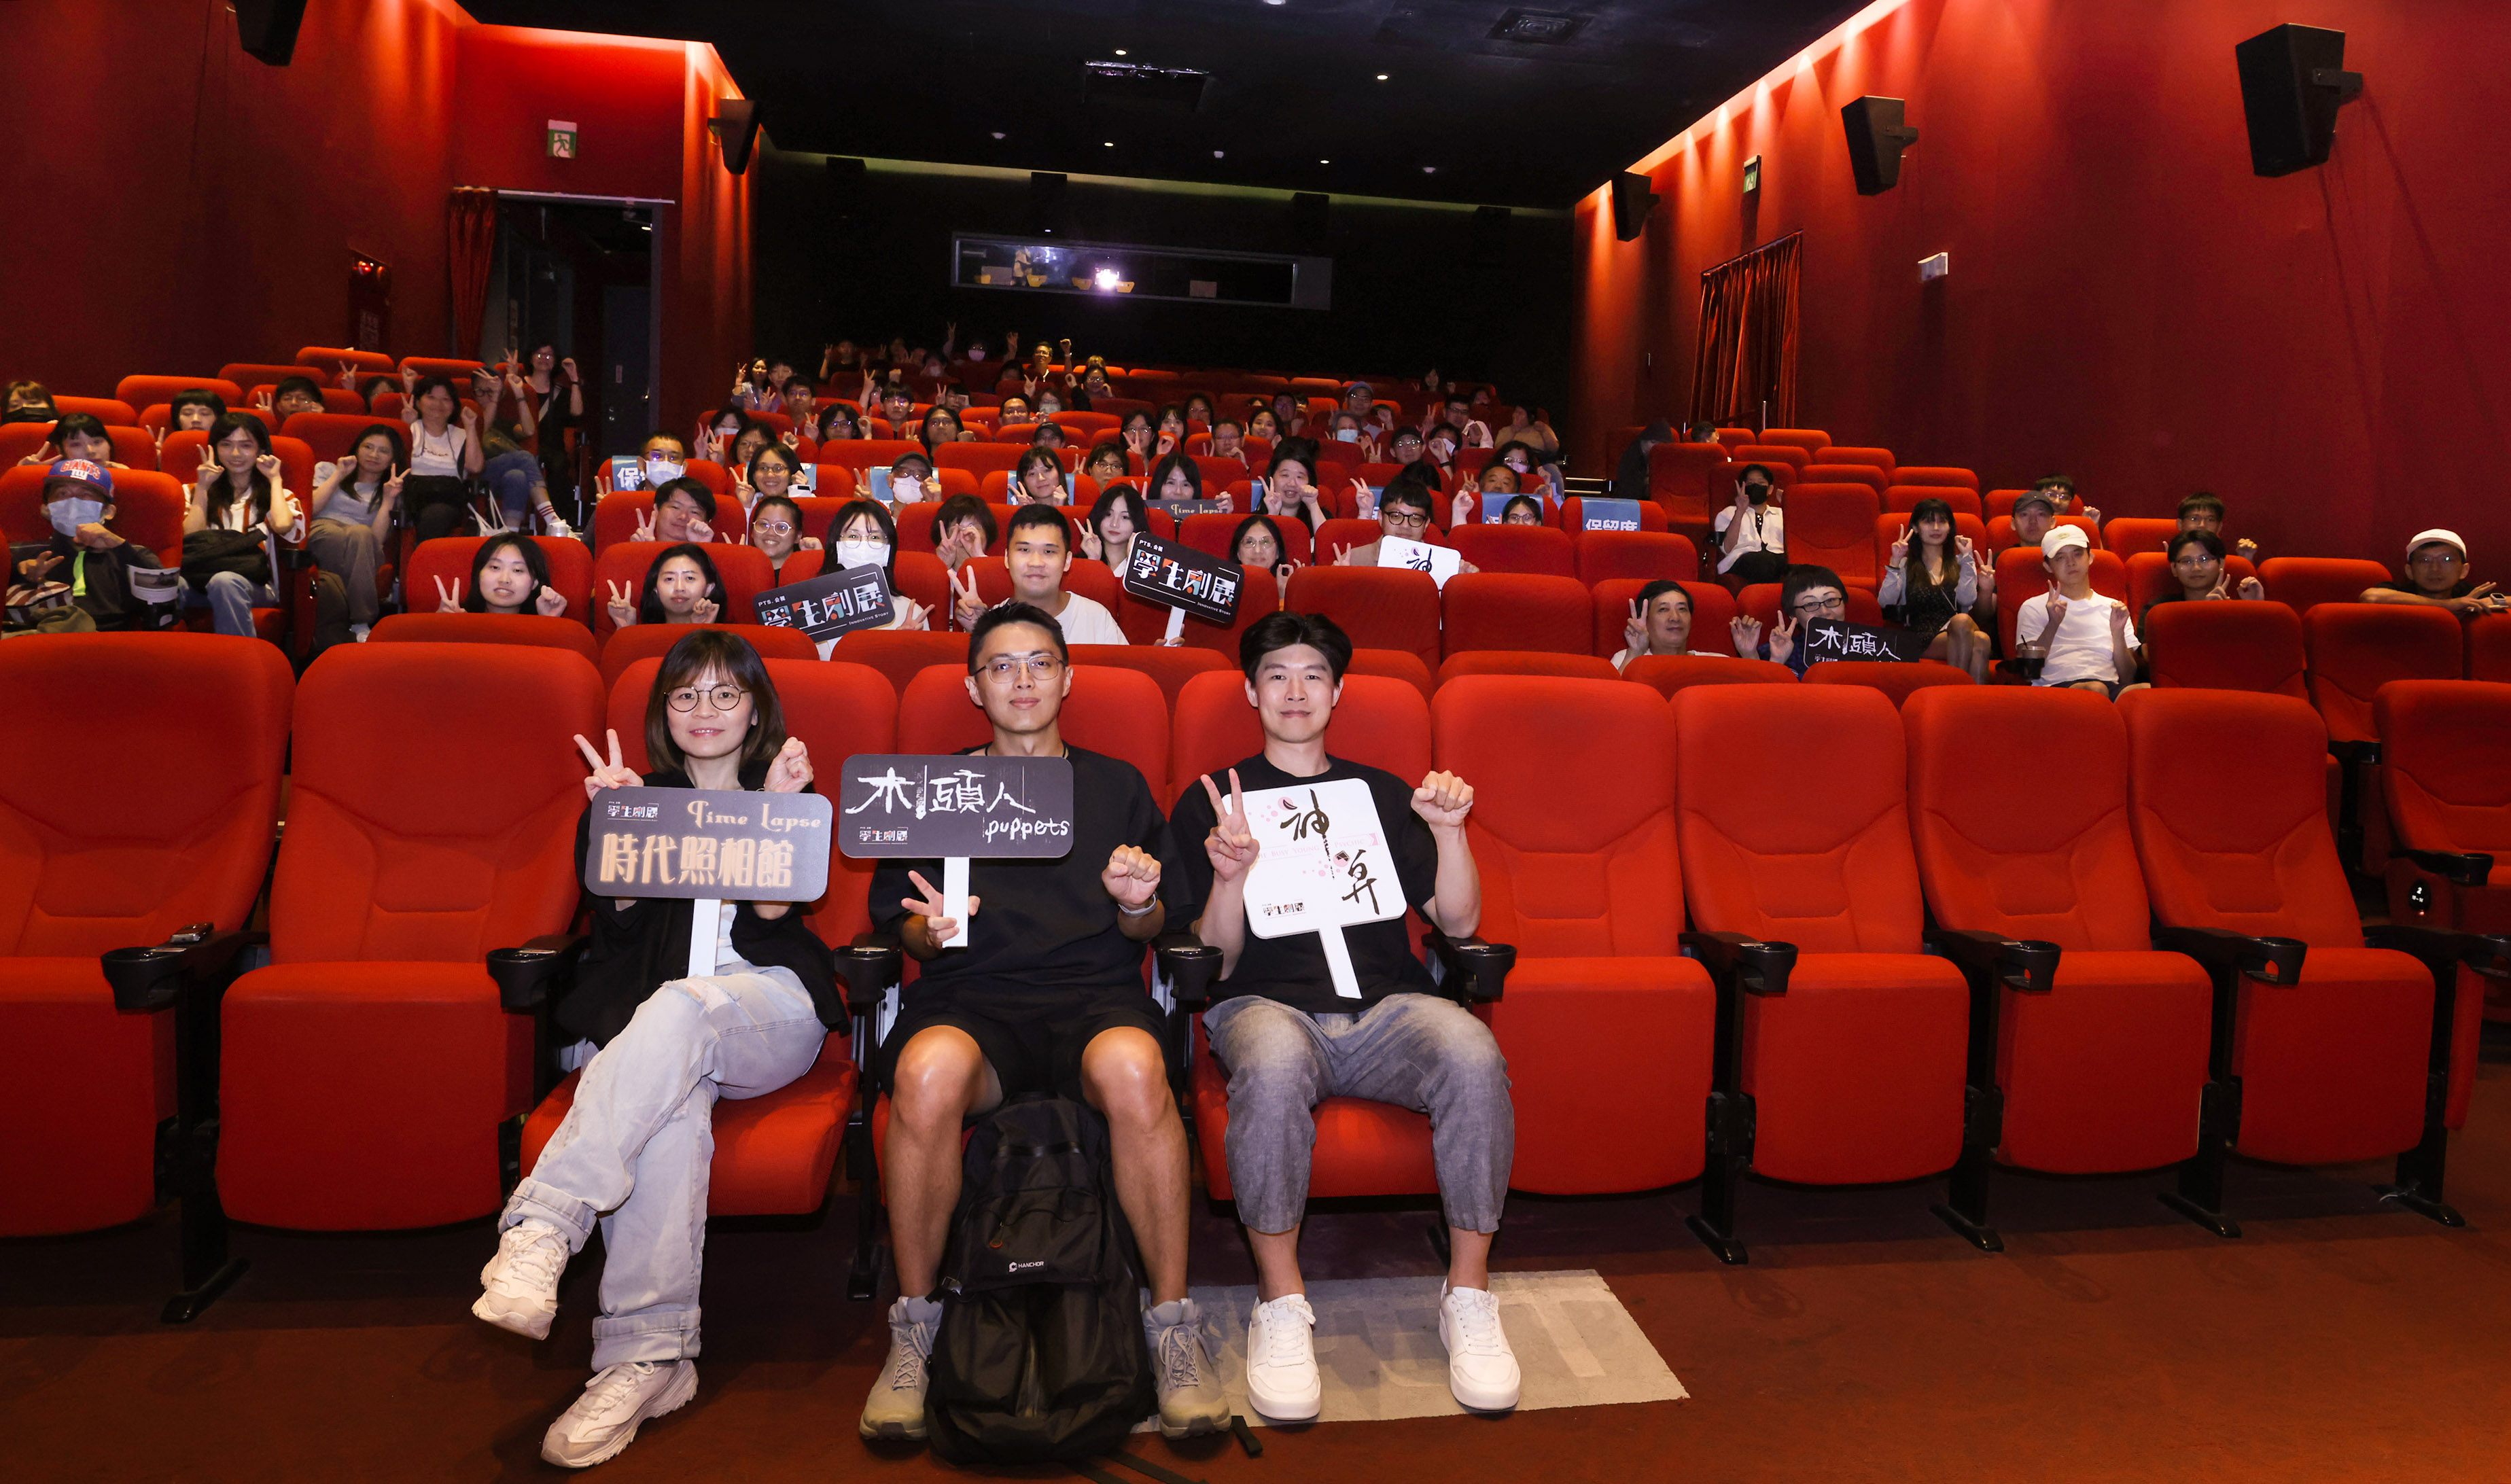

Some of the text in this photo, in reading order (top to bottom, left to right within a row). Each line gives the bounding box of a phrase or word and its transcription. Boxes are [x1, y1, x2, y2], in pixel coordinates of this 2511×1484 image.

[60, 460, 101, 480] GIANTS
[1171, 504, 1195, 515] Time
[1133, 548, 1236, 607] 學生劇展
[1808, 626, 1901, 660] 木頭人
[845, 766, 1036, 819] 木頭人
[687, 800, 821, 832] Time Lapse
[985, 817, 1070, 843] puppets
[600, 833, 794, 888] 時代照相館
